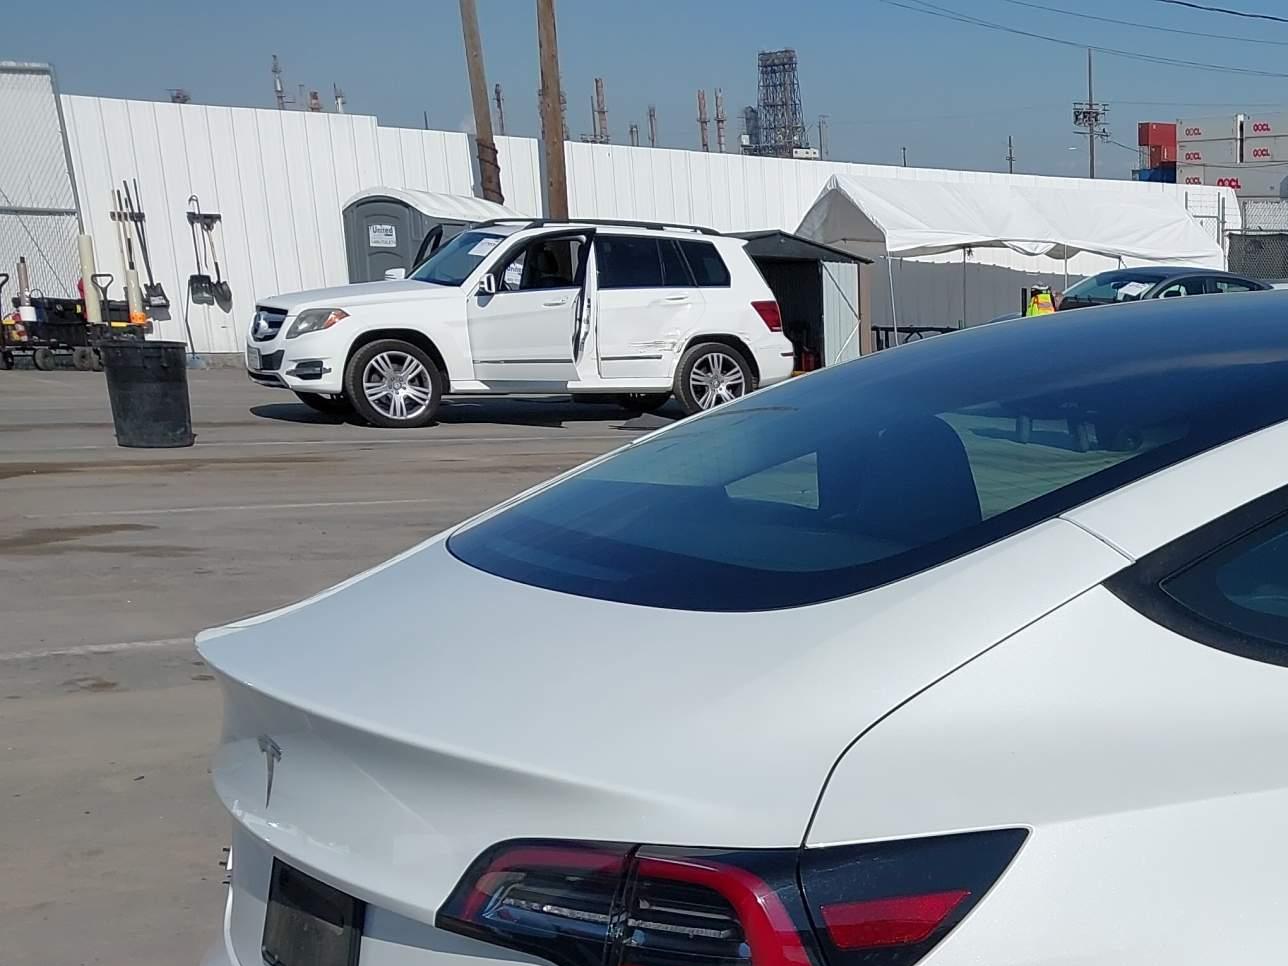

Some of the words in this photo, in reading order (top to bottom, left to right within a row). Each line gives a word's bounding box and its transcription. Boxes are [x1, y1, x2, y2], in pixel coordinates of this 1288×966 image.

[1185, 127, 1202, 137] OOCL
[1253, 123, 1271, 133] OOCL
[1185, 152, 1202, 161] OOCL
[1252, 148, 1271, 158] OOCL
